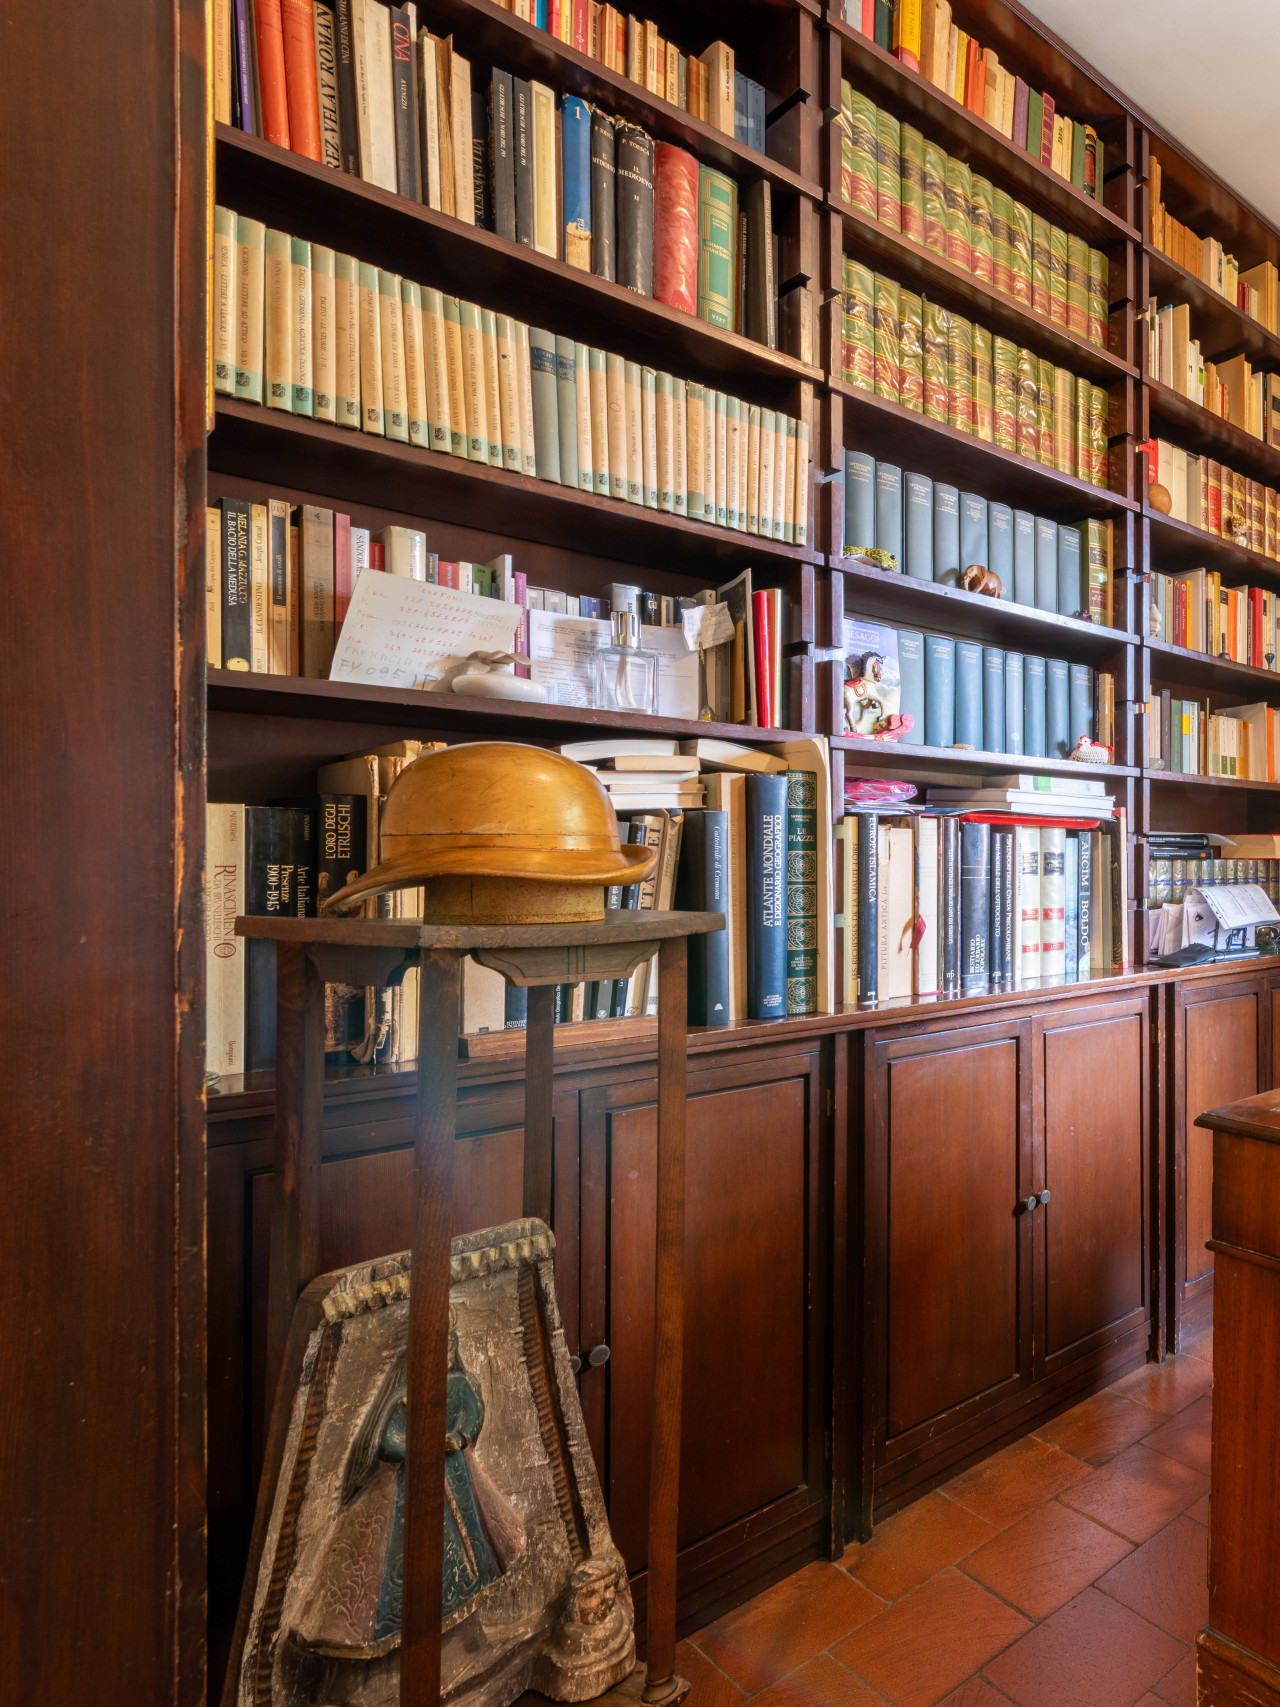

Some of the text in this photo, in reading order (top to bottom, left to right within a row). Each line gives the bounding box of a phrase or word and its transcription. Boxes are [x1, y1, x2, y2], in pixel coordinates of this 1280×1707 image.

[315, 5, 336, 77] ROMAN
[393, 22, 411, 62] CINA
[400, 84, 408, 110] VENEZIA
[574, 107, 582, 120] 1
[618, 168, 653, 189] MEDIOEVO
[633, 165, 640, 174] IL
[237, 513, 247, 549] MELANIA
[255, 525, 264, 563] Joseph Conrad
[227, 511, 238, 606] IL BACIO DELLA MEDUSA
[237, 559, 248, 603] MAZZUCCO
[255, 581, 264, 626] CLANDESTINO
[325, 804, 336, 859] L'ORO DEGLI
[337, 804, 351, 859] ETRUSCHI
[713, 825, 722, 861] Cattedrale
[774, 814, 783, 870] GEOGRAFICO
[788, 834, 815, 842] PIAZZE
[796, 827, 807, 835] LE
[763, 814, 774, 928] ATLANTE MONDIALE
[868, 816, 878, 903] EUROPA ISLAMICA
[267, 864, 280, 911] 1900-1945
[281, 864, 294, 903] Presenze
[297, 865, 310, 918] Arte Italiana
[713, 870, 722, 900] Cremona
[774, 871, 783, 919] DIZIONARIO
[1080, 841, 1090, 946] ARCIM BOLDO
[851, 909, 858, 921] DE
